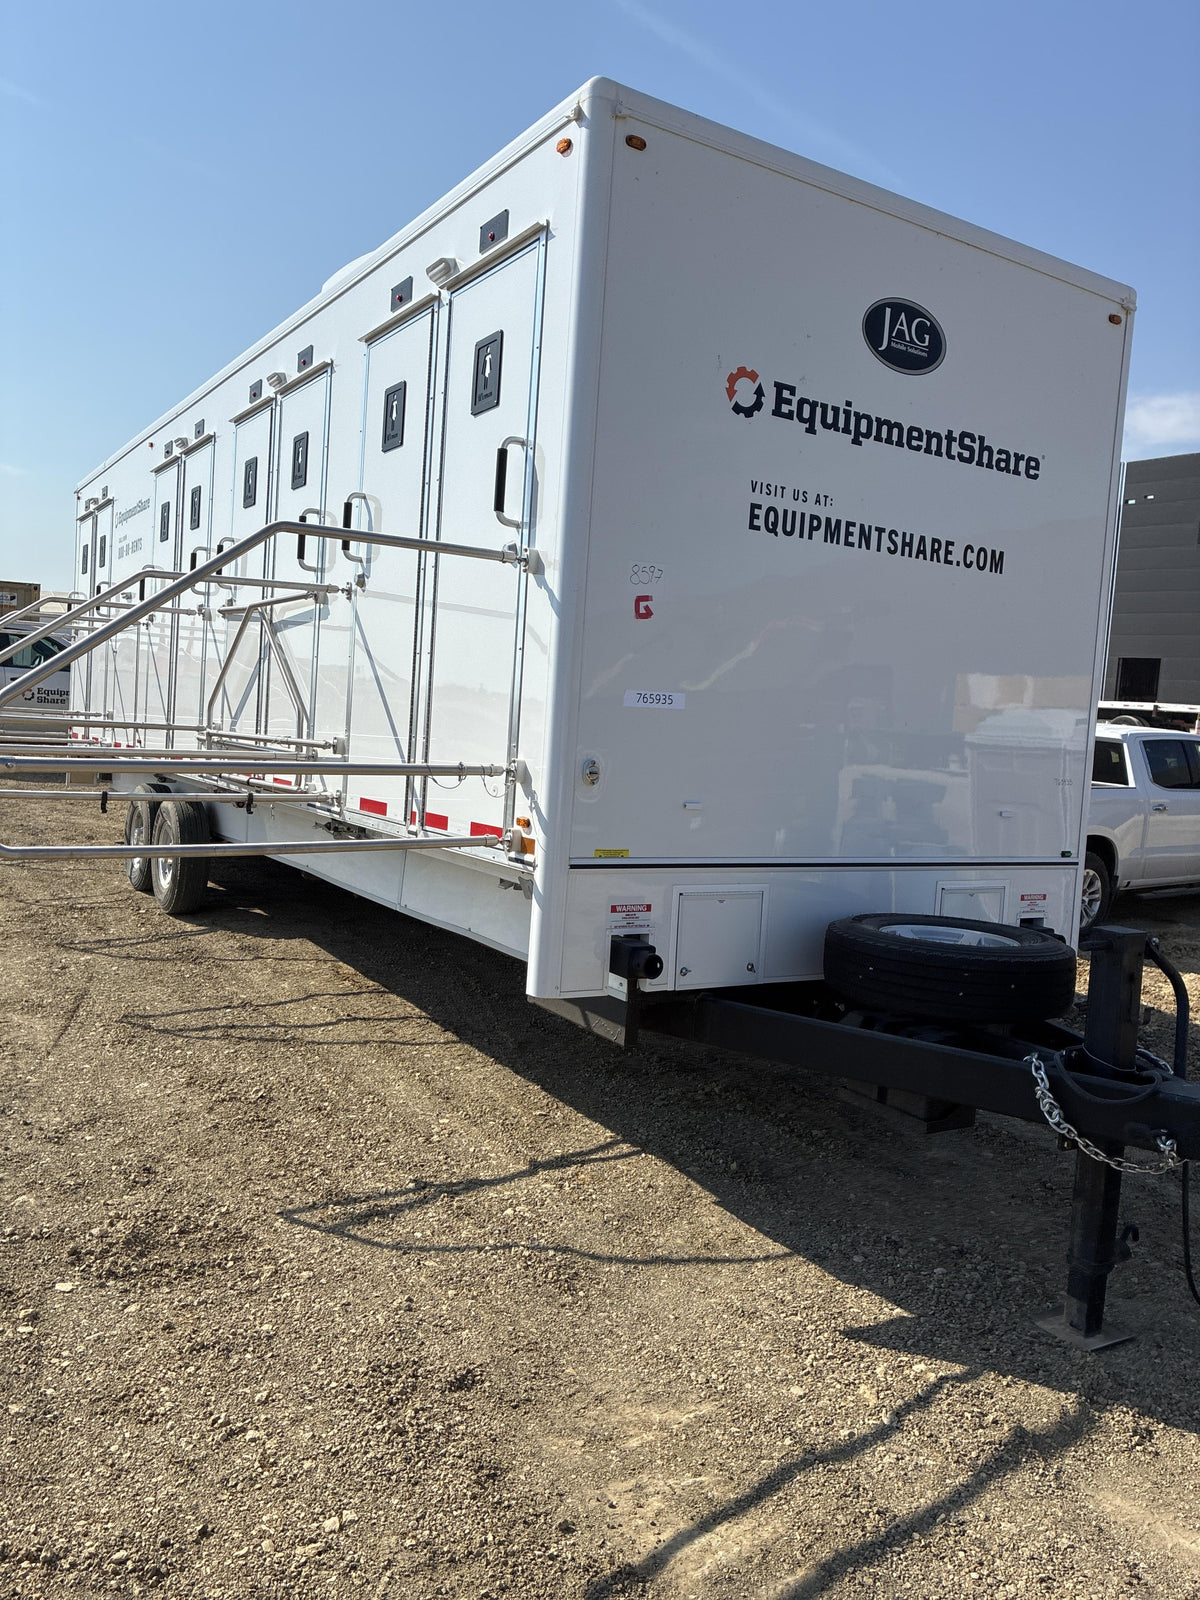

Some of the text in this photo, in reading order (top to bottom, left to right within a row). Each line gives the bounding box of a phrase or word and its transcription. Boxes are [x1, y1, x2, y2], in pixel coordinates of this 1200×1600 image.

[878, 307, 931, 351] JAG
[771, 380, 1041, 480] EquipmentShare
[750, 479, 834, 507] VISIT US AT:
[748, 502, 1005, 575] EQUIPMENTSHARE.COM
[629, 564, 664, 585] 8597
[37, 695, 66, 705] Share
[636, 692, 674, 705] 765935
[615, 904, 648, 912] WARNING
